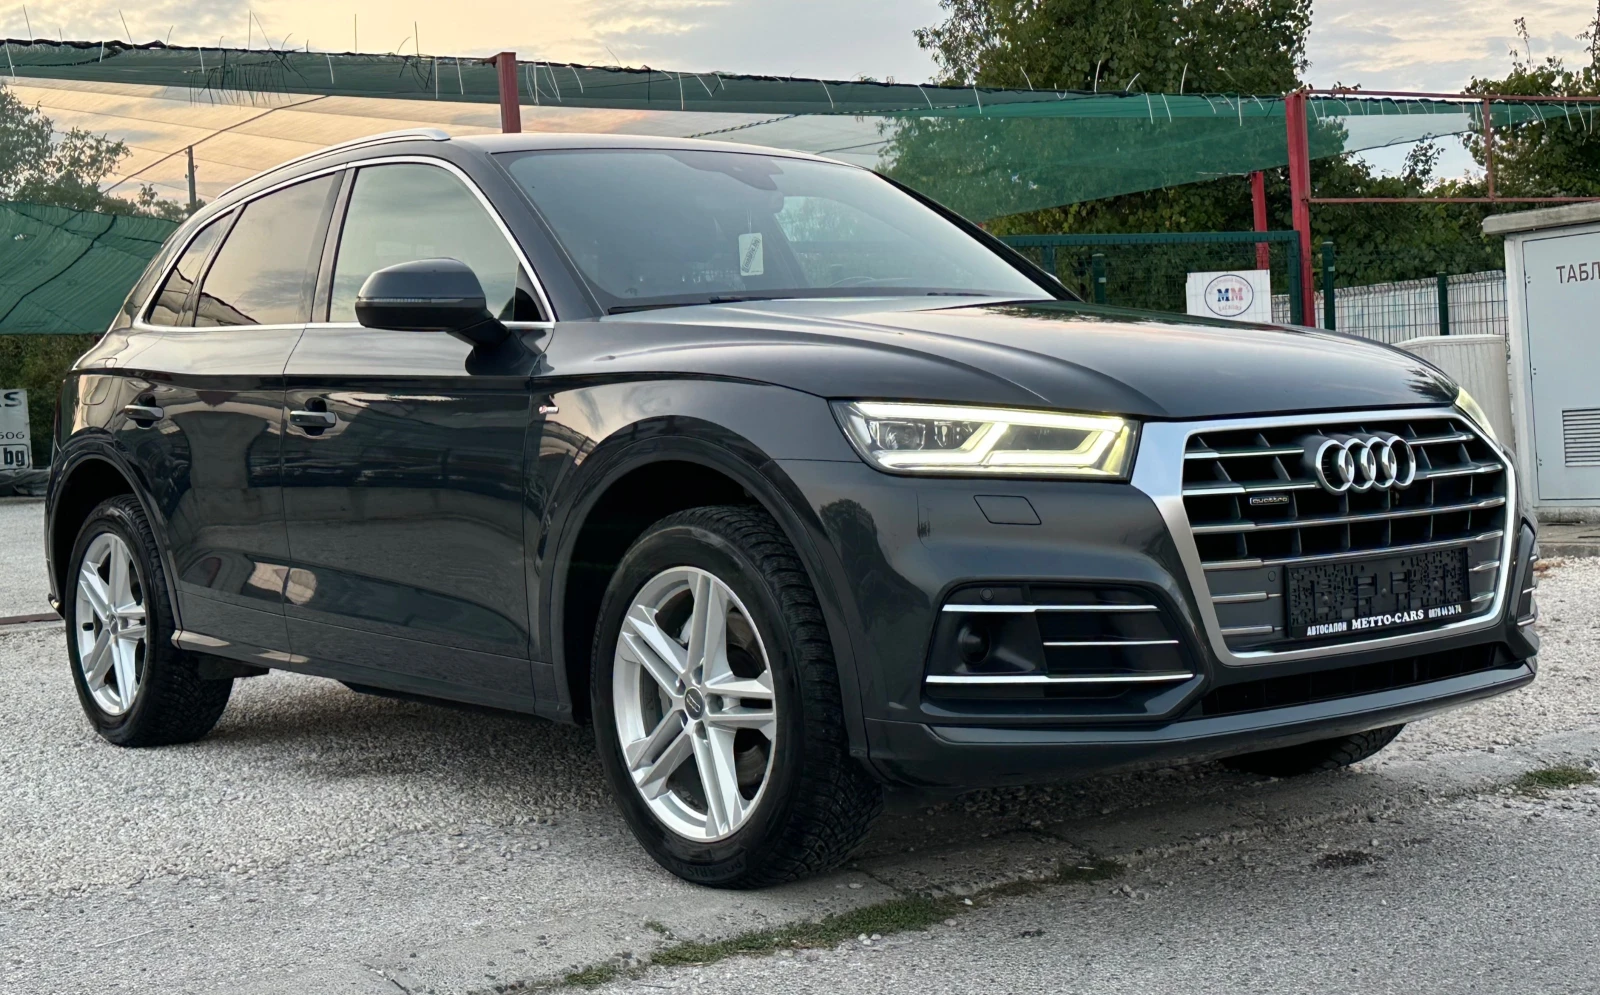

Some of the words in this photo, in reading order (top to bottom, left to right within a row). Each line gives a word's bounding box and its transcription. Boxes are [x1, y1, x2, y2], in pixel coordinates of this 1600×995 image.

[1555, 262, 1600, 284] ТАБЛ
[0, 391, 22, 407] S
[3, 447, 25, 467] bg
[1351, 609, 1425, 630] METTO-CARS
